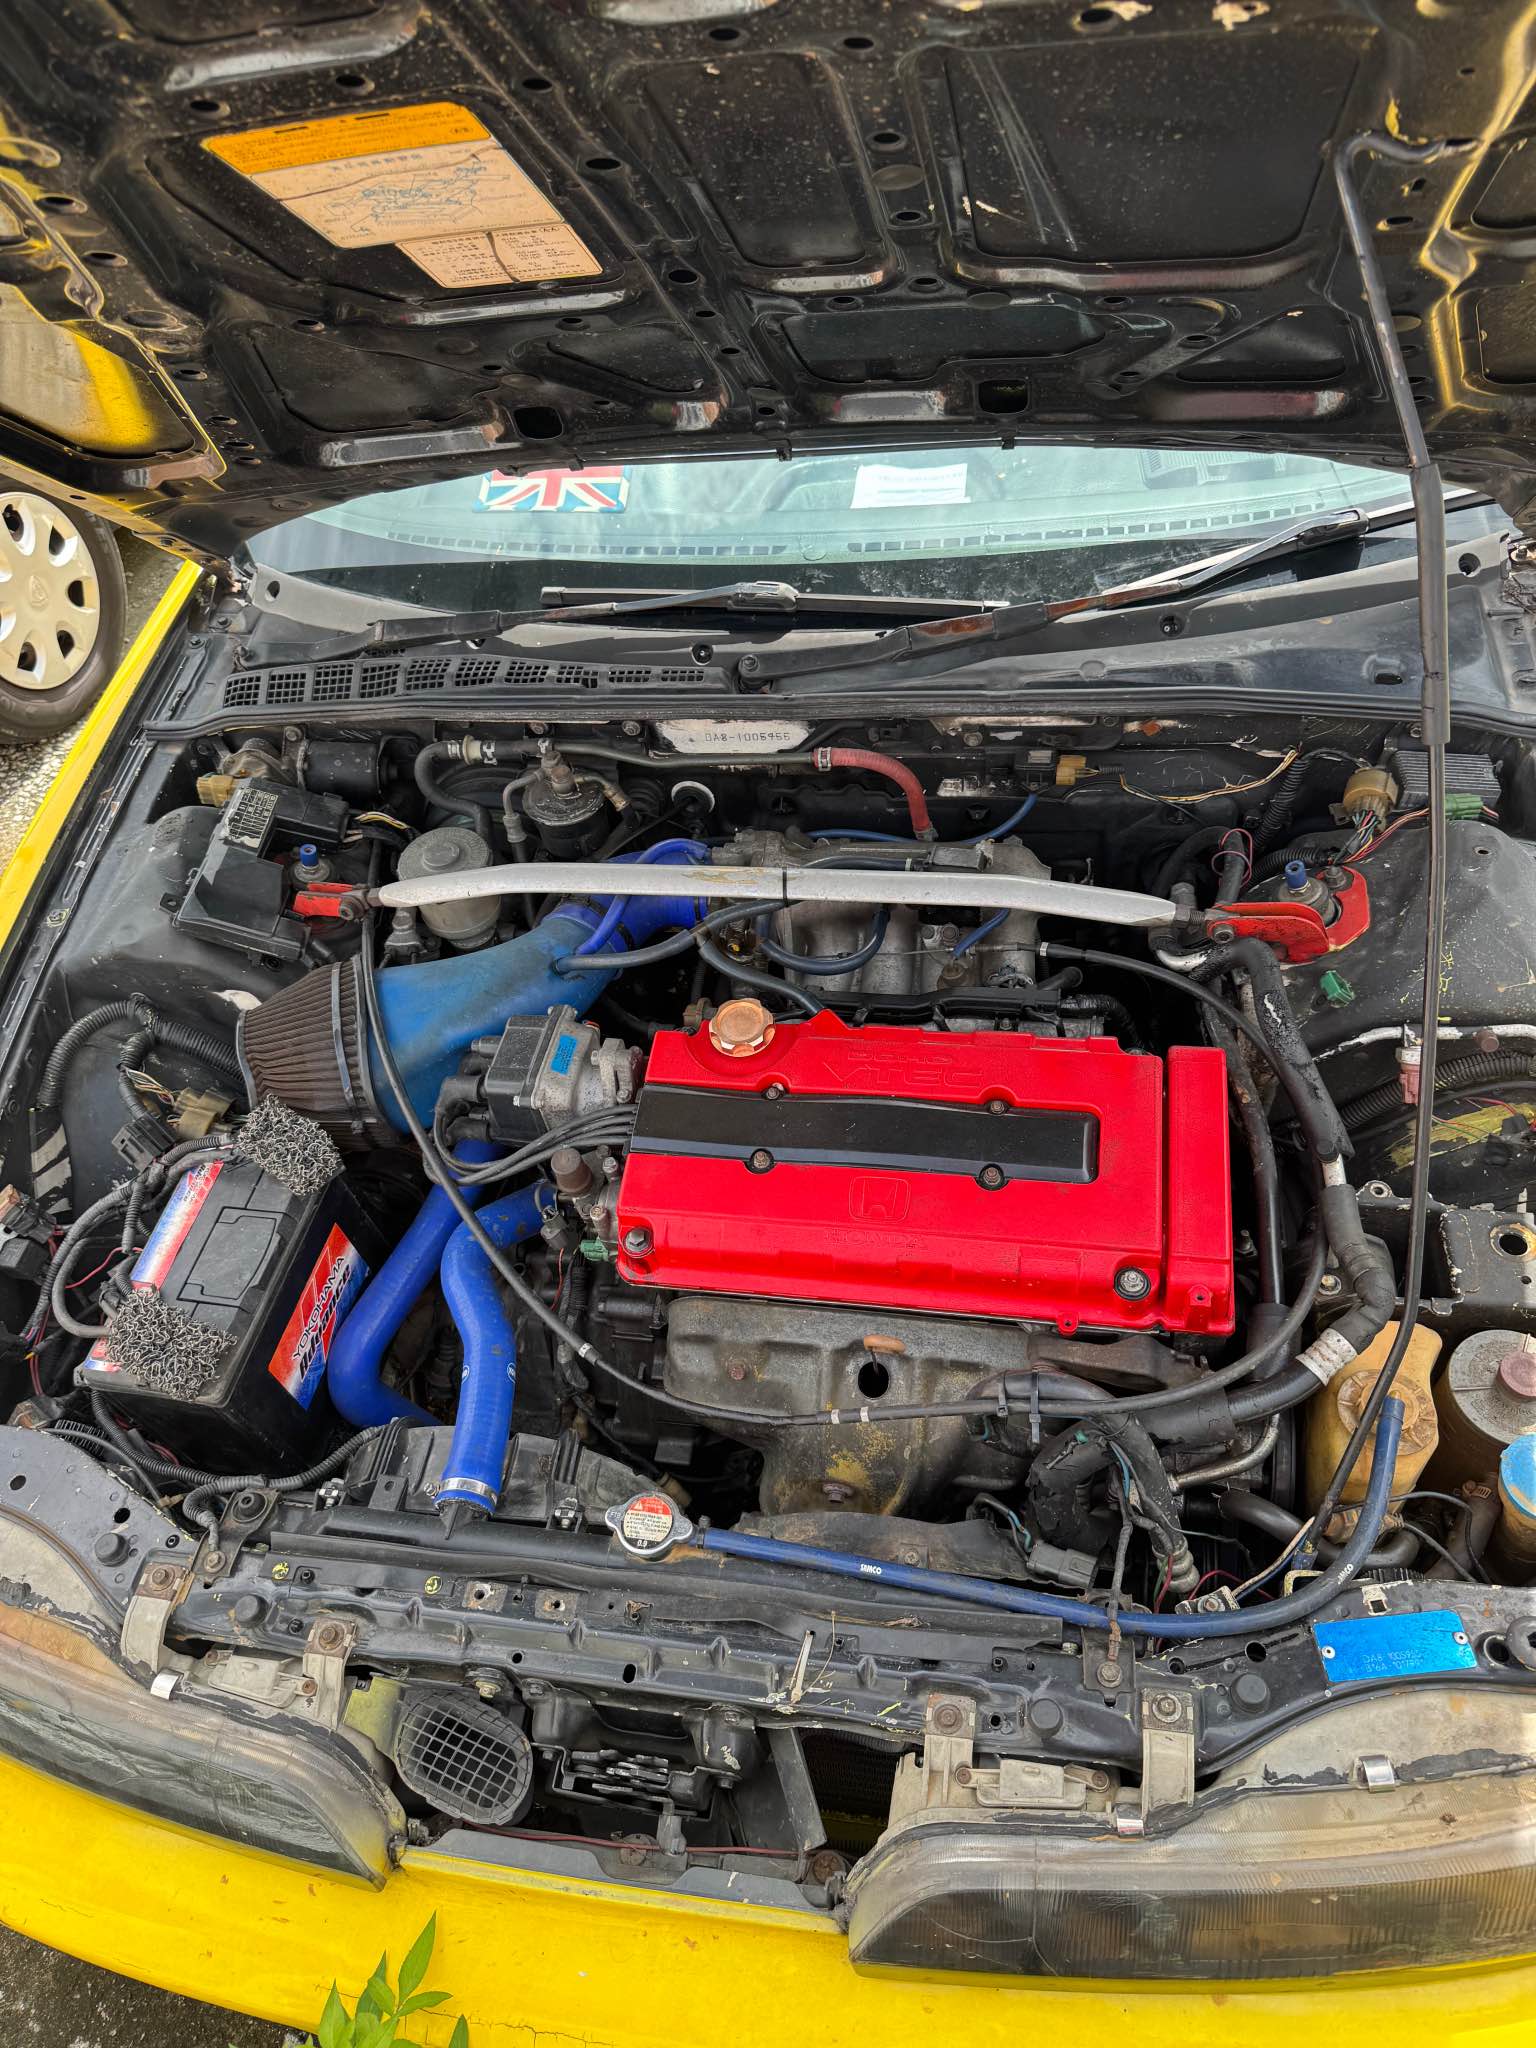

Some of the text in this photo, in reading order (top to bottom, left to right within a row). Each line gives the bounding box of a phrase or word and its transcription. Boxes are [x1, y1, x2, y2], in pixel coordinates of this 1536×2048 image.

[822, 1060, 985, 1088] VTEC
[292, 1256, 345, 1360] YOKOHAMA
[860, 1563, 882, 1575] SAMCO
